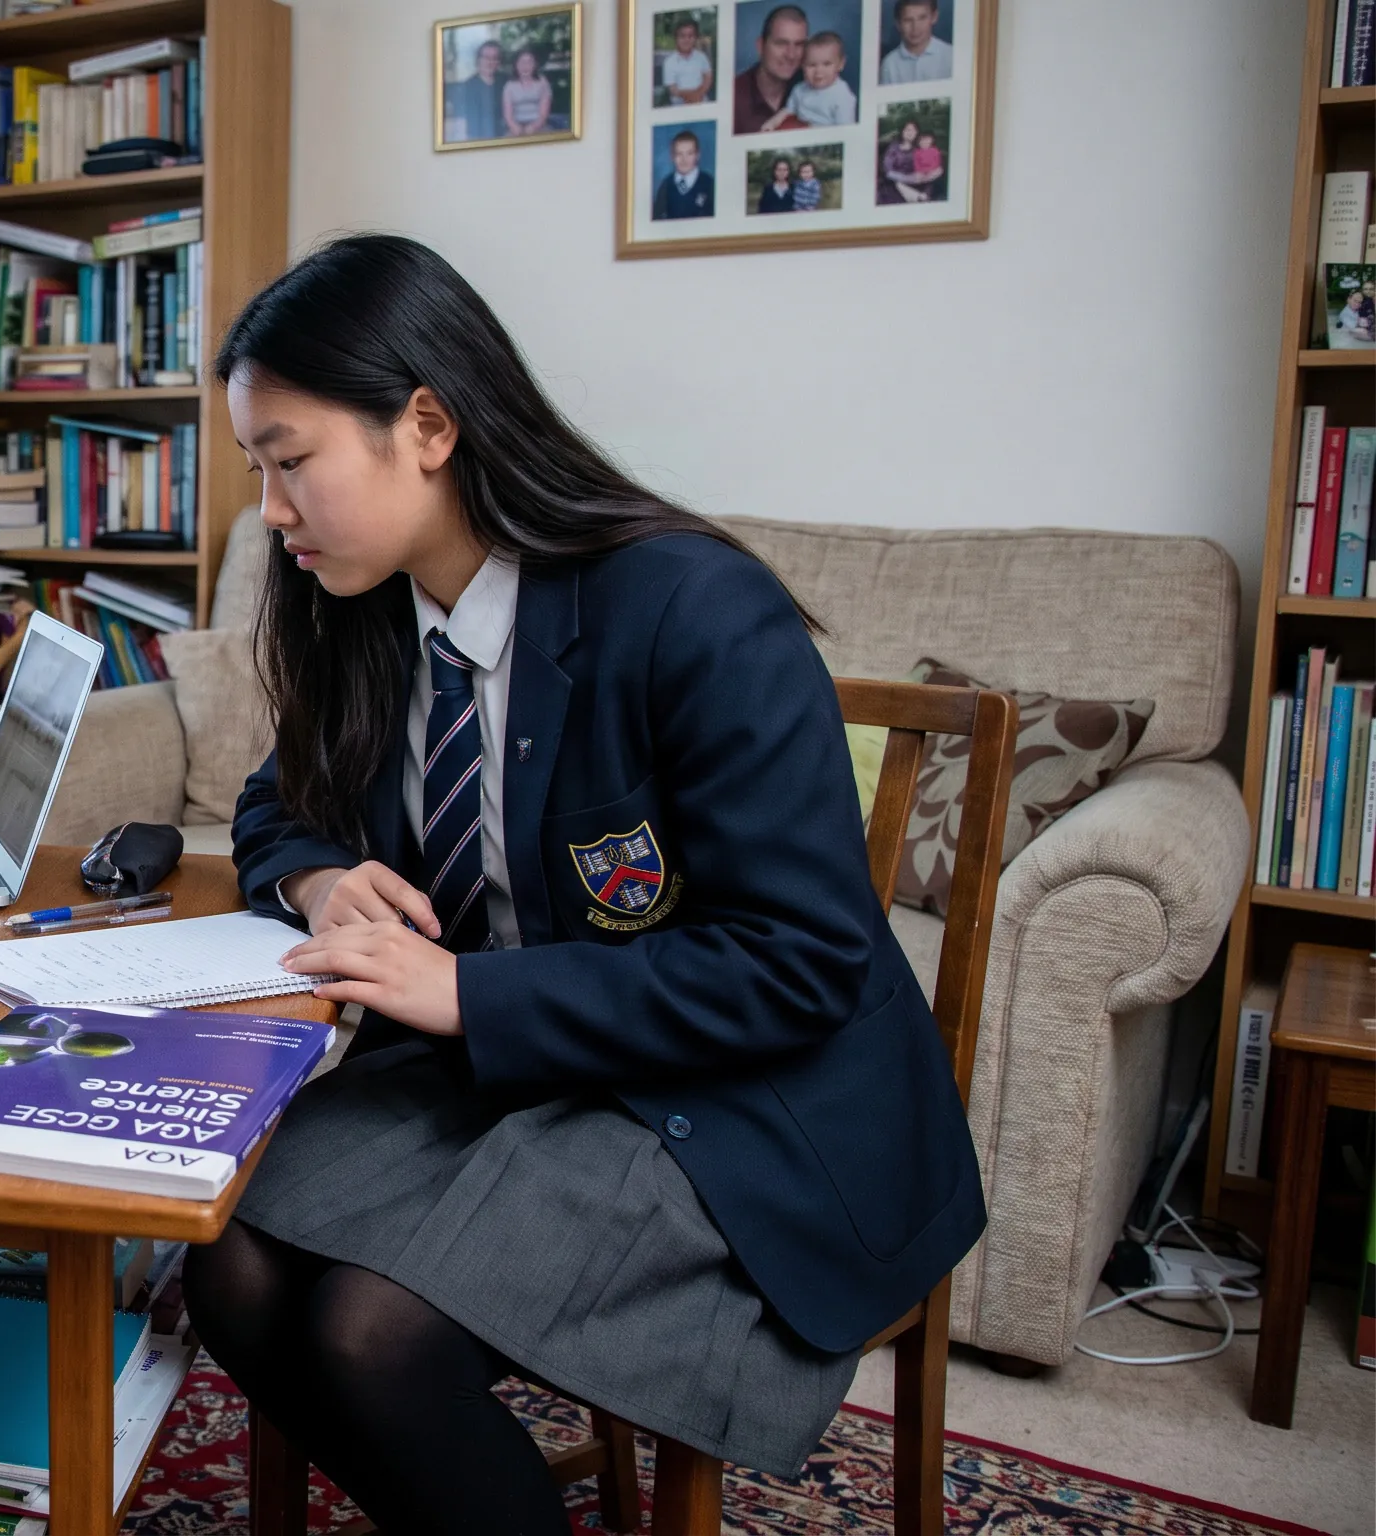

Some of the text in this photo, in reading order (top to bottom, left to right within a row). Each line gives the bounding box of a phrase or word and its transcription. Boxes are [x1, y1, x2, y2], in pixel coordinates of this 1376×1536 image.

[79, 1078, 247, 1109] Science
[5, 1104, 120, 1130] GCSE
[124, 1147, 204, 1167] AQA
